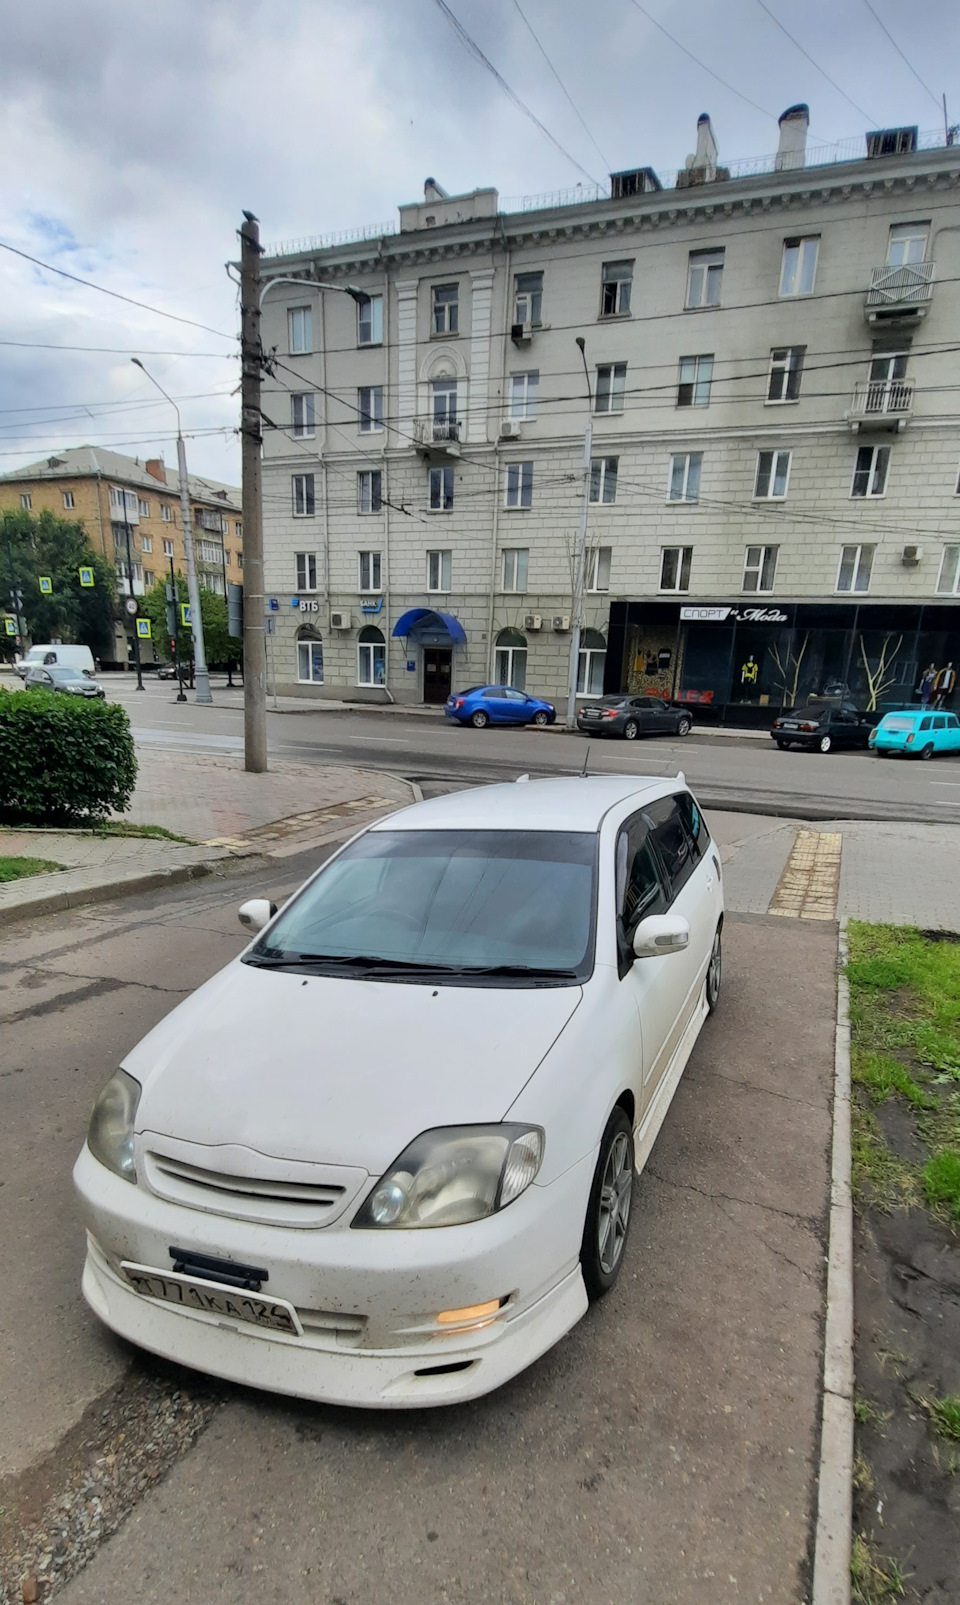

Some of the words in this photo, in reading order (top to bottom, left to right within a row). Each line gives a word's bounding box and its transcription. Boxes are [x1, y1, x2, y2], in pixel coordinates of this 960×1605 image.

[300, 600, 319, 612] ВТБ
[683, 609, 724, 618] СПОРТ
[736, 608, 788, 621] Мода
